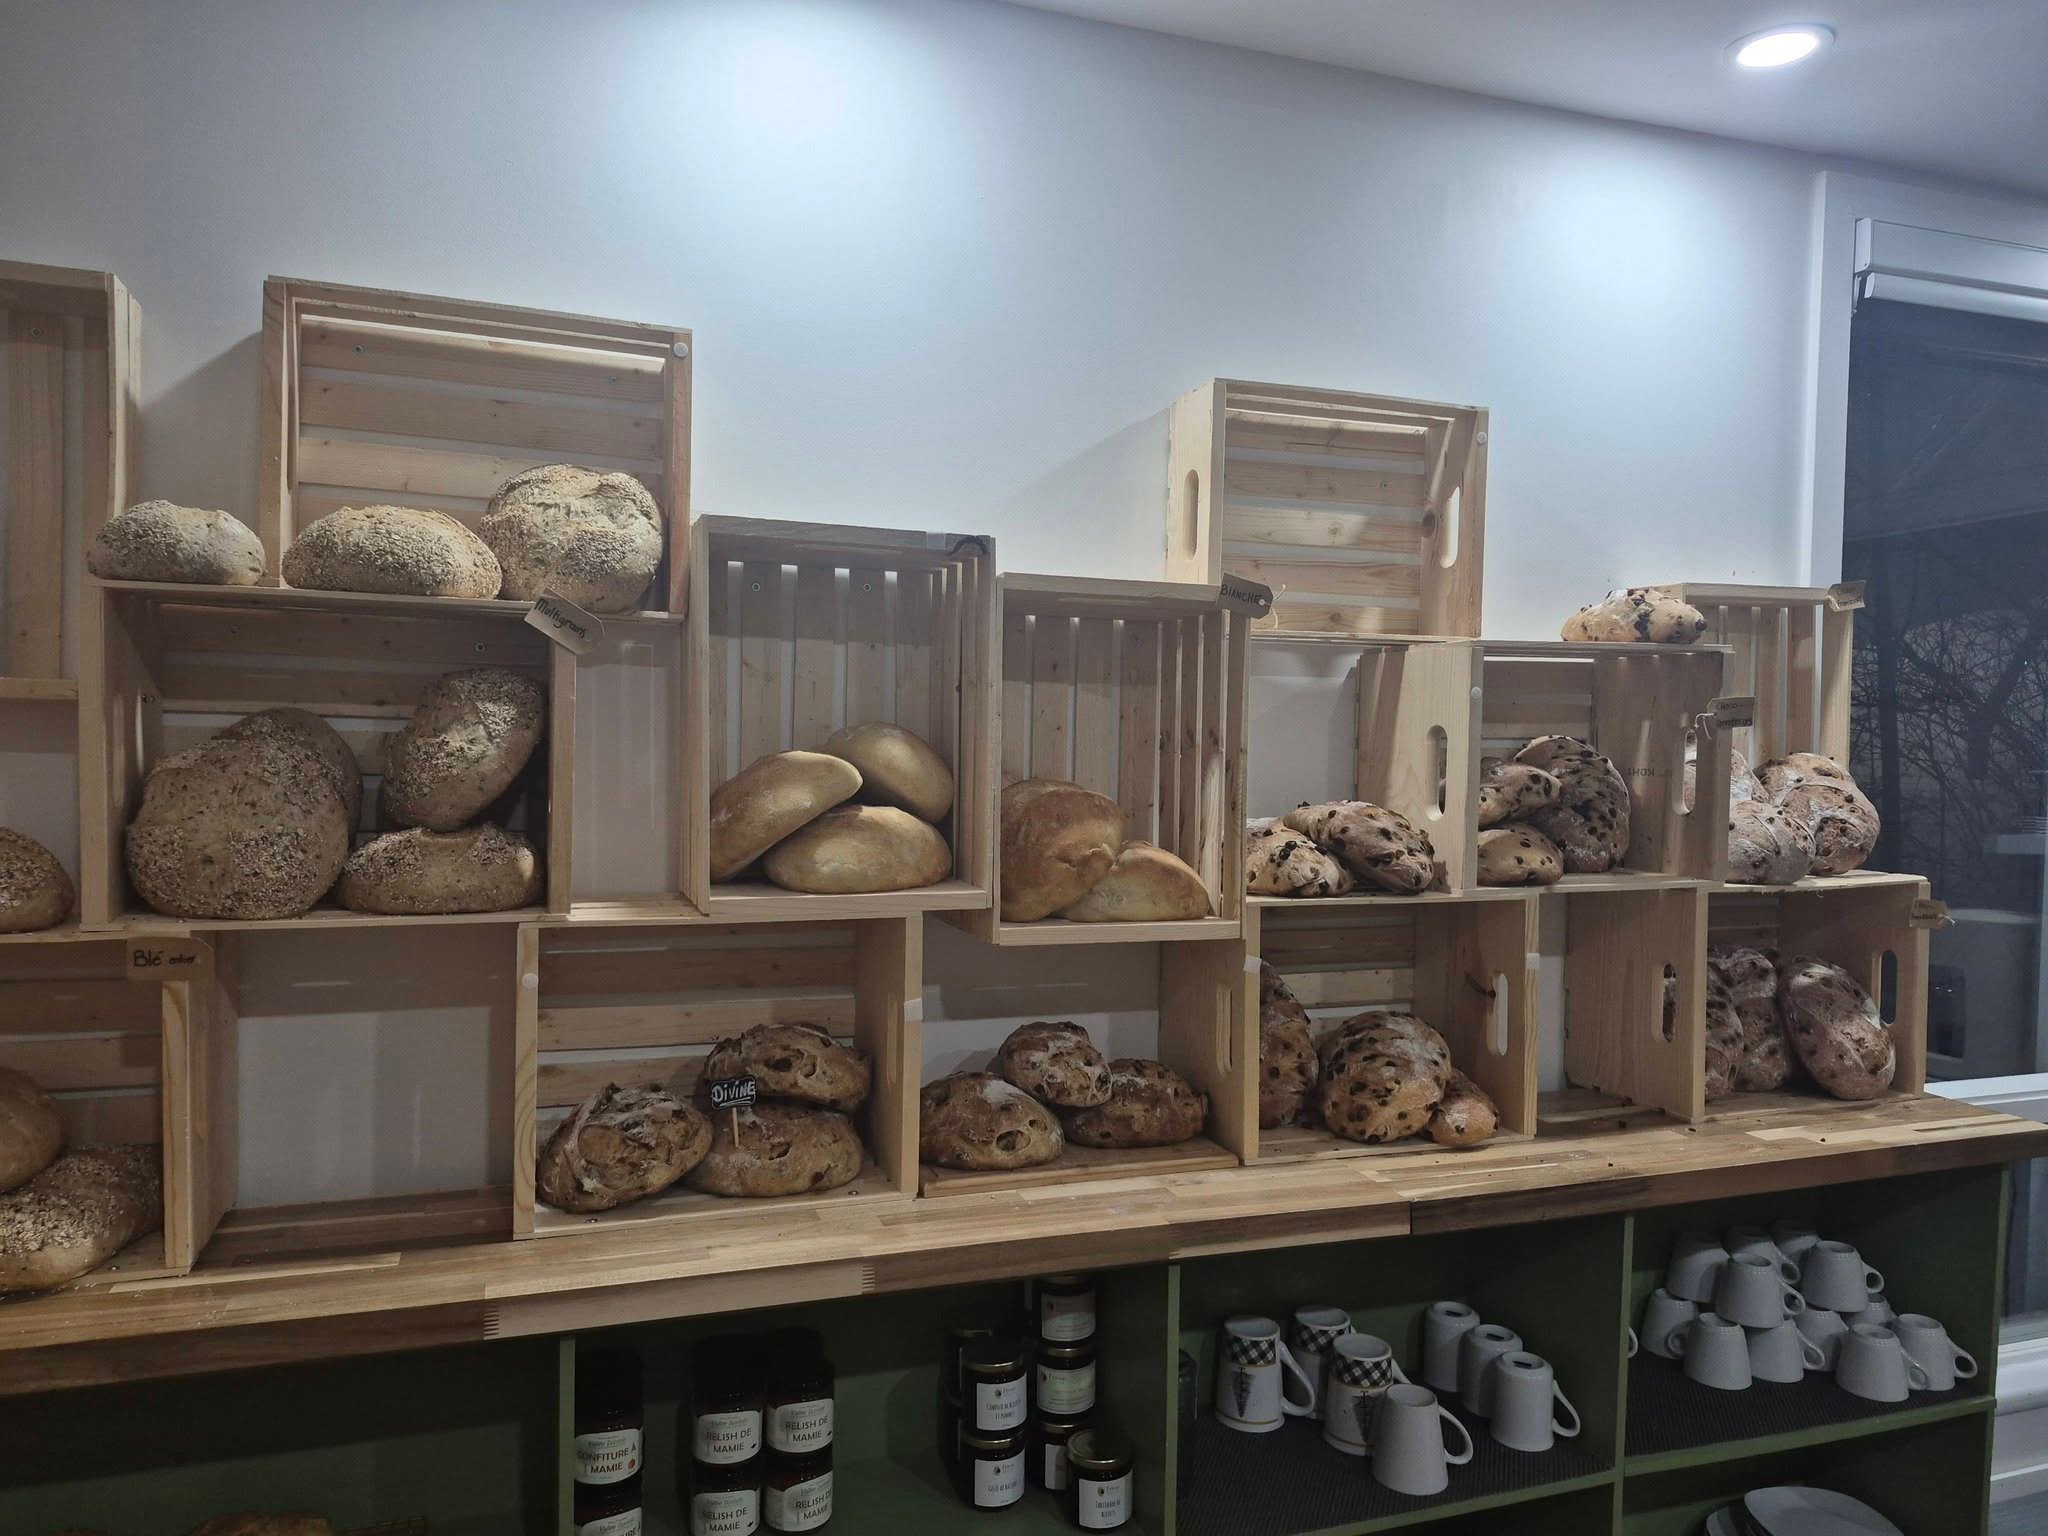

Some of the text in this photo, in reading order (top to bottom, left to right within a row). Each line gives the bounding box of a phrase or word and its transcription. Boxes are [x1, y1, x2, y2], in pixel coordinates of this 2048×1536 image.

[134, 949, 164, 967] Blé
[785, 1415, 829, 1431] RELISH DE
[706, 1427, 752, 1441] RELISH DE
[792, 1430, 823, 1442] MAMIE
[577, 1447, 630, 1462] CONFITURE
[713, 1442, 745, 1453] MAMIE
[590, 1461, 624, 1474] MAMIE
[795, 1488, 833, 1510] RELISH D
[736, 1507, 748, 1517] DE
[803, 1502, 829, 1520] MAMIE
[709, 1520, 741, 1532] MAMIE
